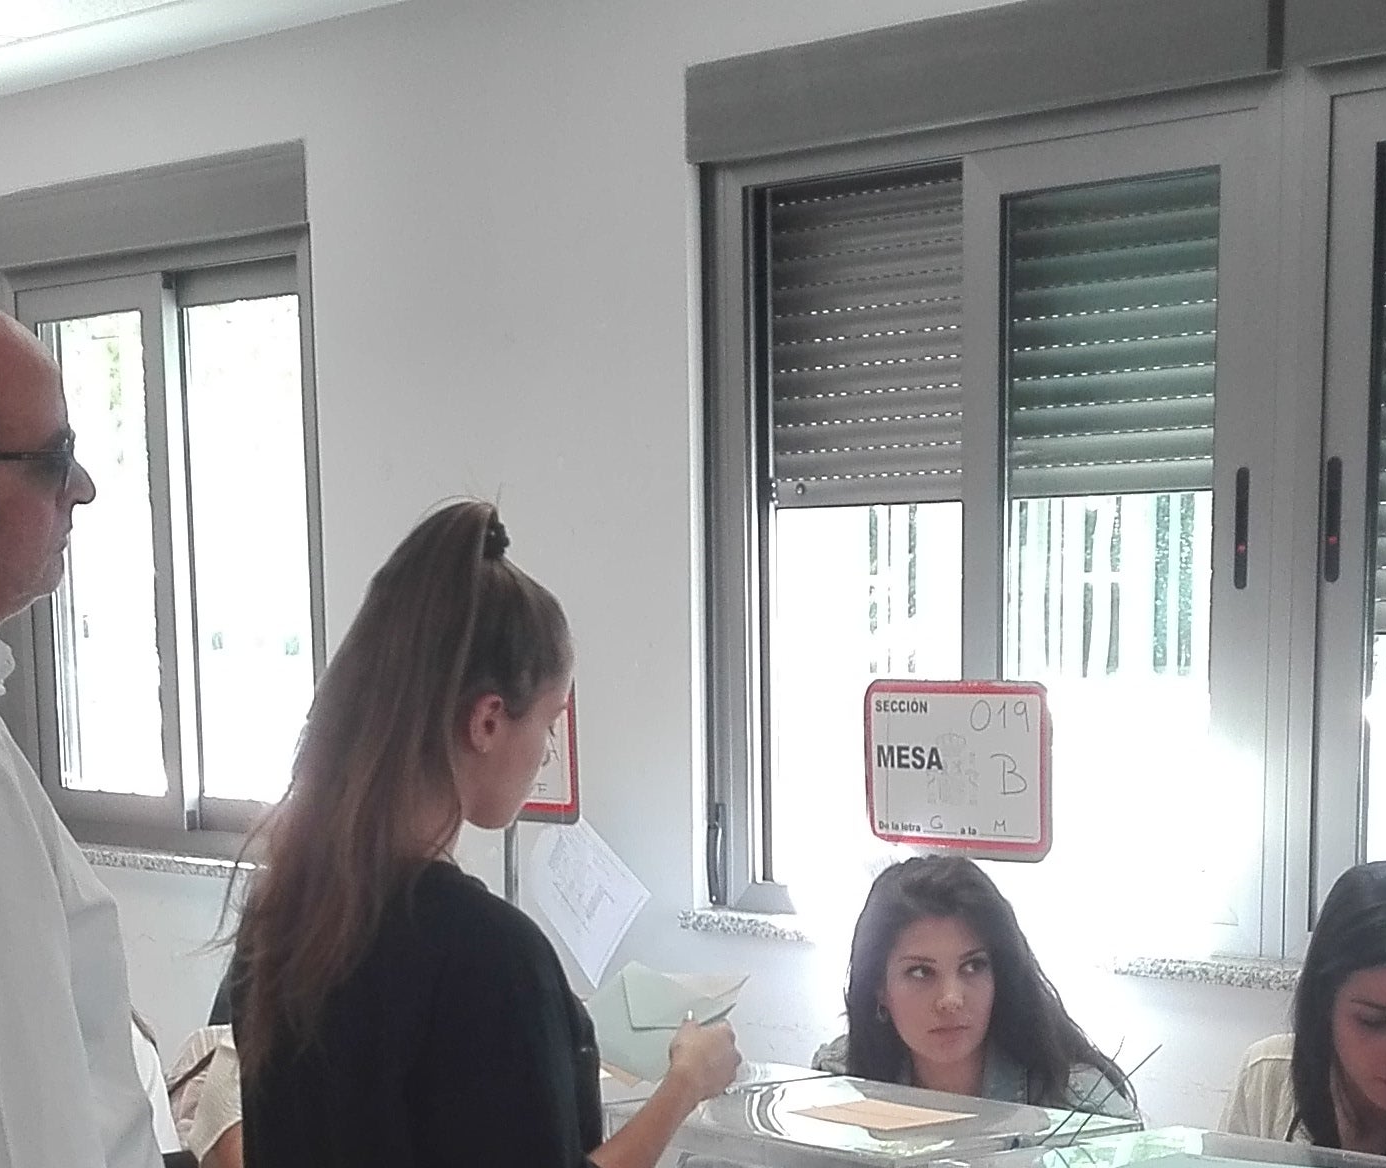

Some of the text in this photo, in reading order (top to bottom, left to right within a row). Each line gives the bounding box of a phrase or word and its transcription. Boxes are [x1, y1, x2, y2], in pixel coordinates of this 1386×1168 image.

[875, 698, 928, 713] SECCIÓN
[970, 700, 1030, 733] 019
[876, 745, 943, 770] MESA
[990, 753, 1028, 795] B
[891, 822, 899, 830] la
[901, 822, 921, 832] letra
[960, 826, 977, 835] a la
